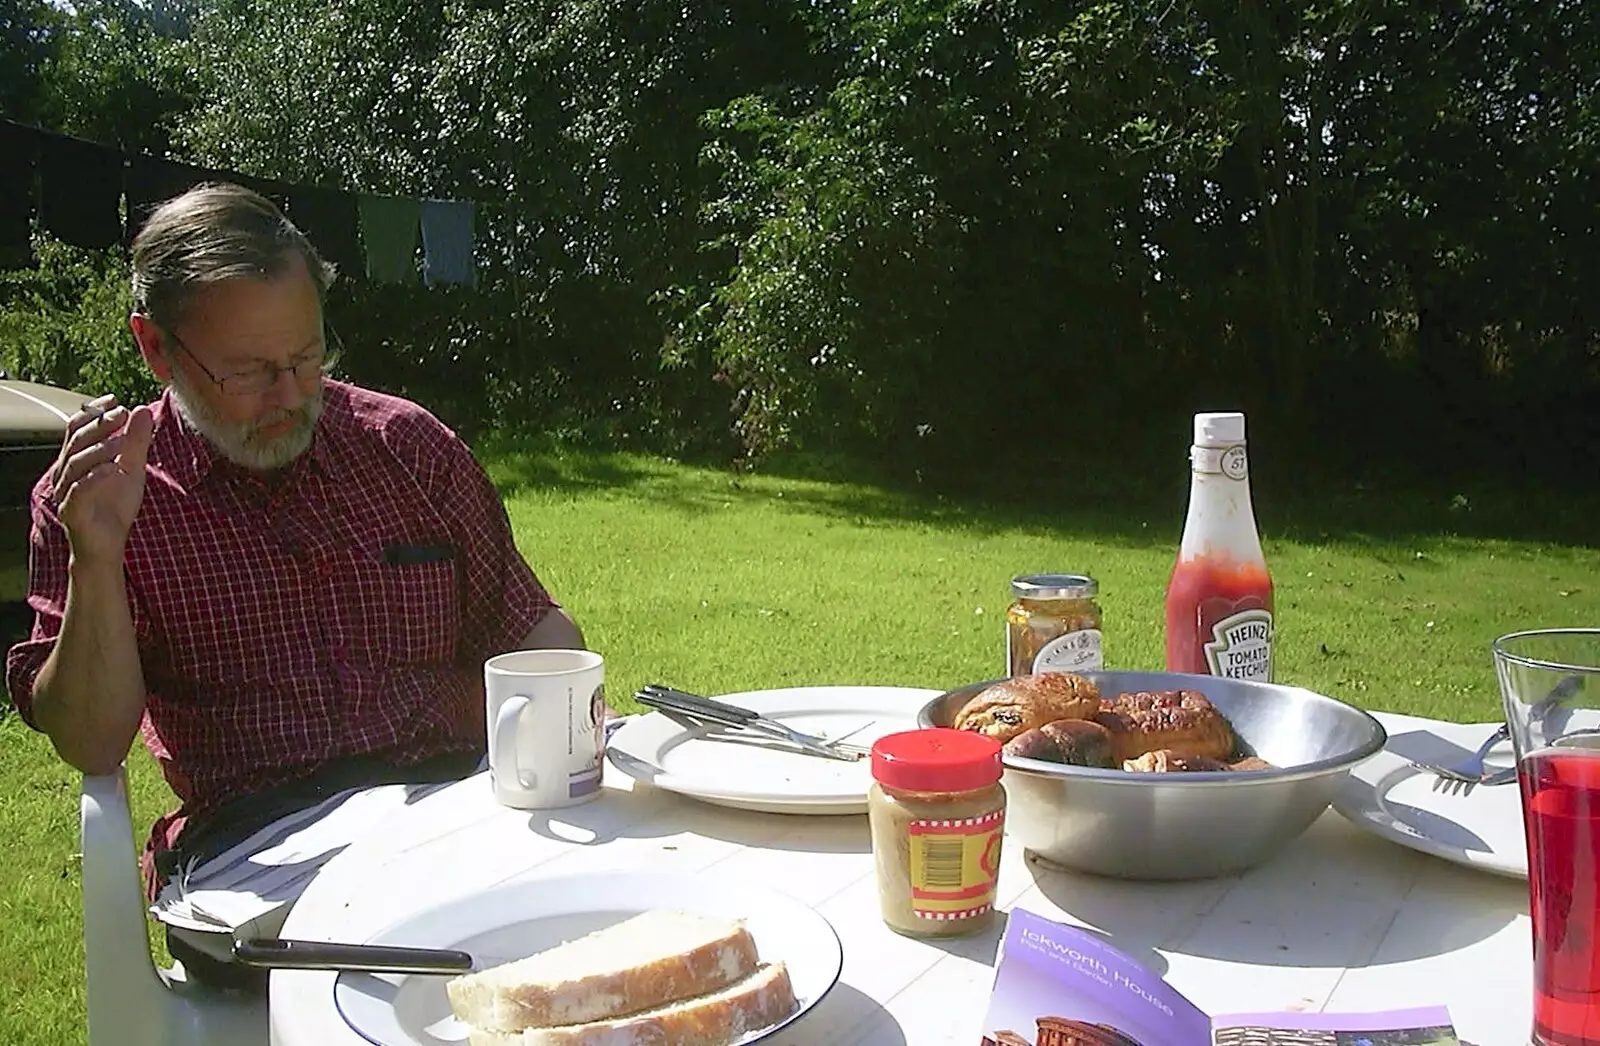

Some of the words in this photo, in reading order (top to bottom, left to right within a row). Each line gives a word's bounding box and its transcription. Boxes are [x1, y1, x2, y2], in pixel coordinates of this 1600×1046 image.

[1230, 625, 1266, 645] HEINZ
[1228, 647, 1267, 665] TOMATO
[1020, 937, 1047, 954] Park
[1023, 928, 1108, 975] Ickworth
[1114, 970, 1174, 1017] House
